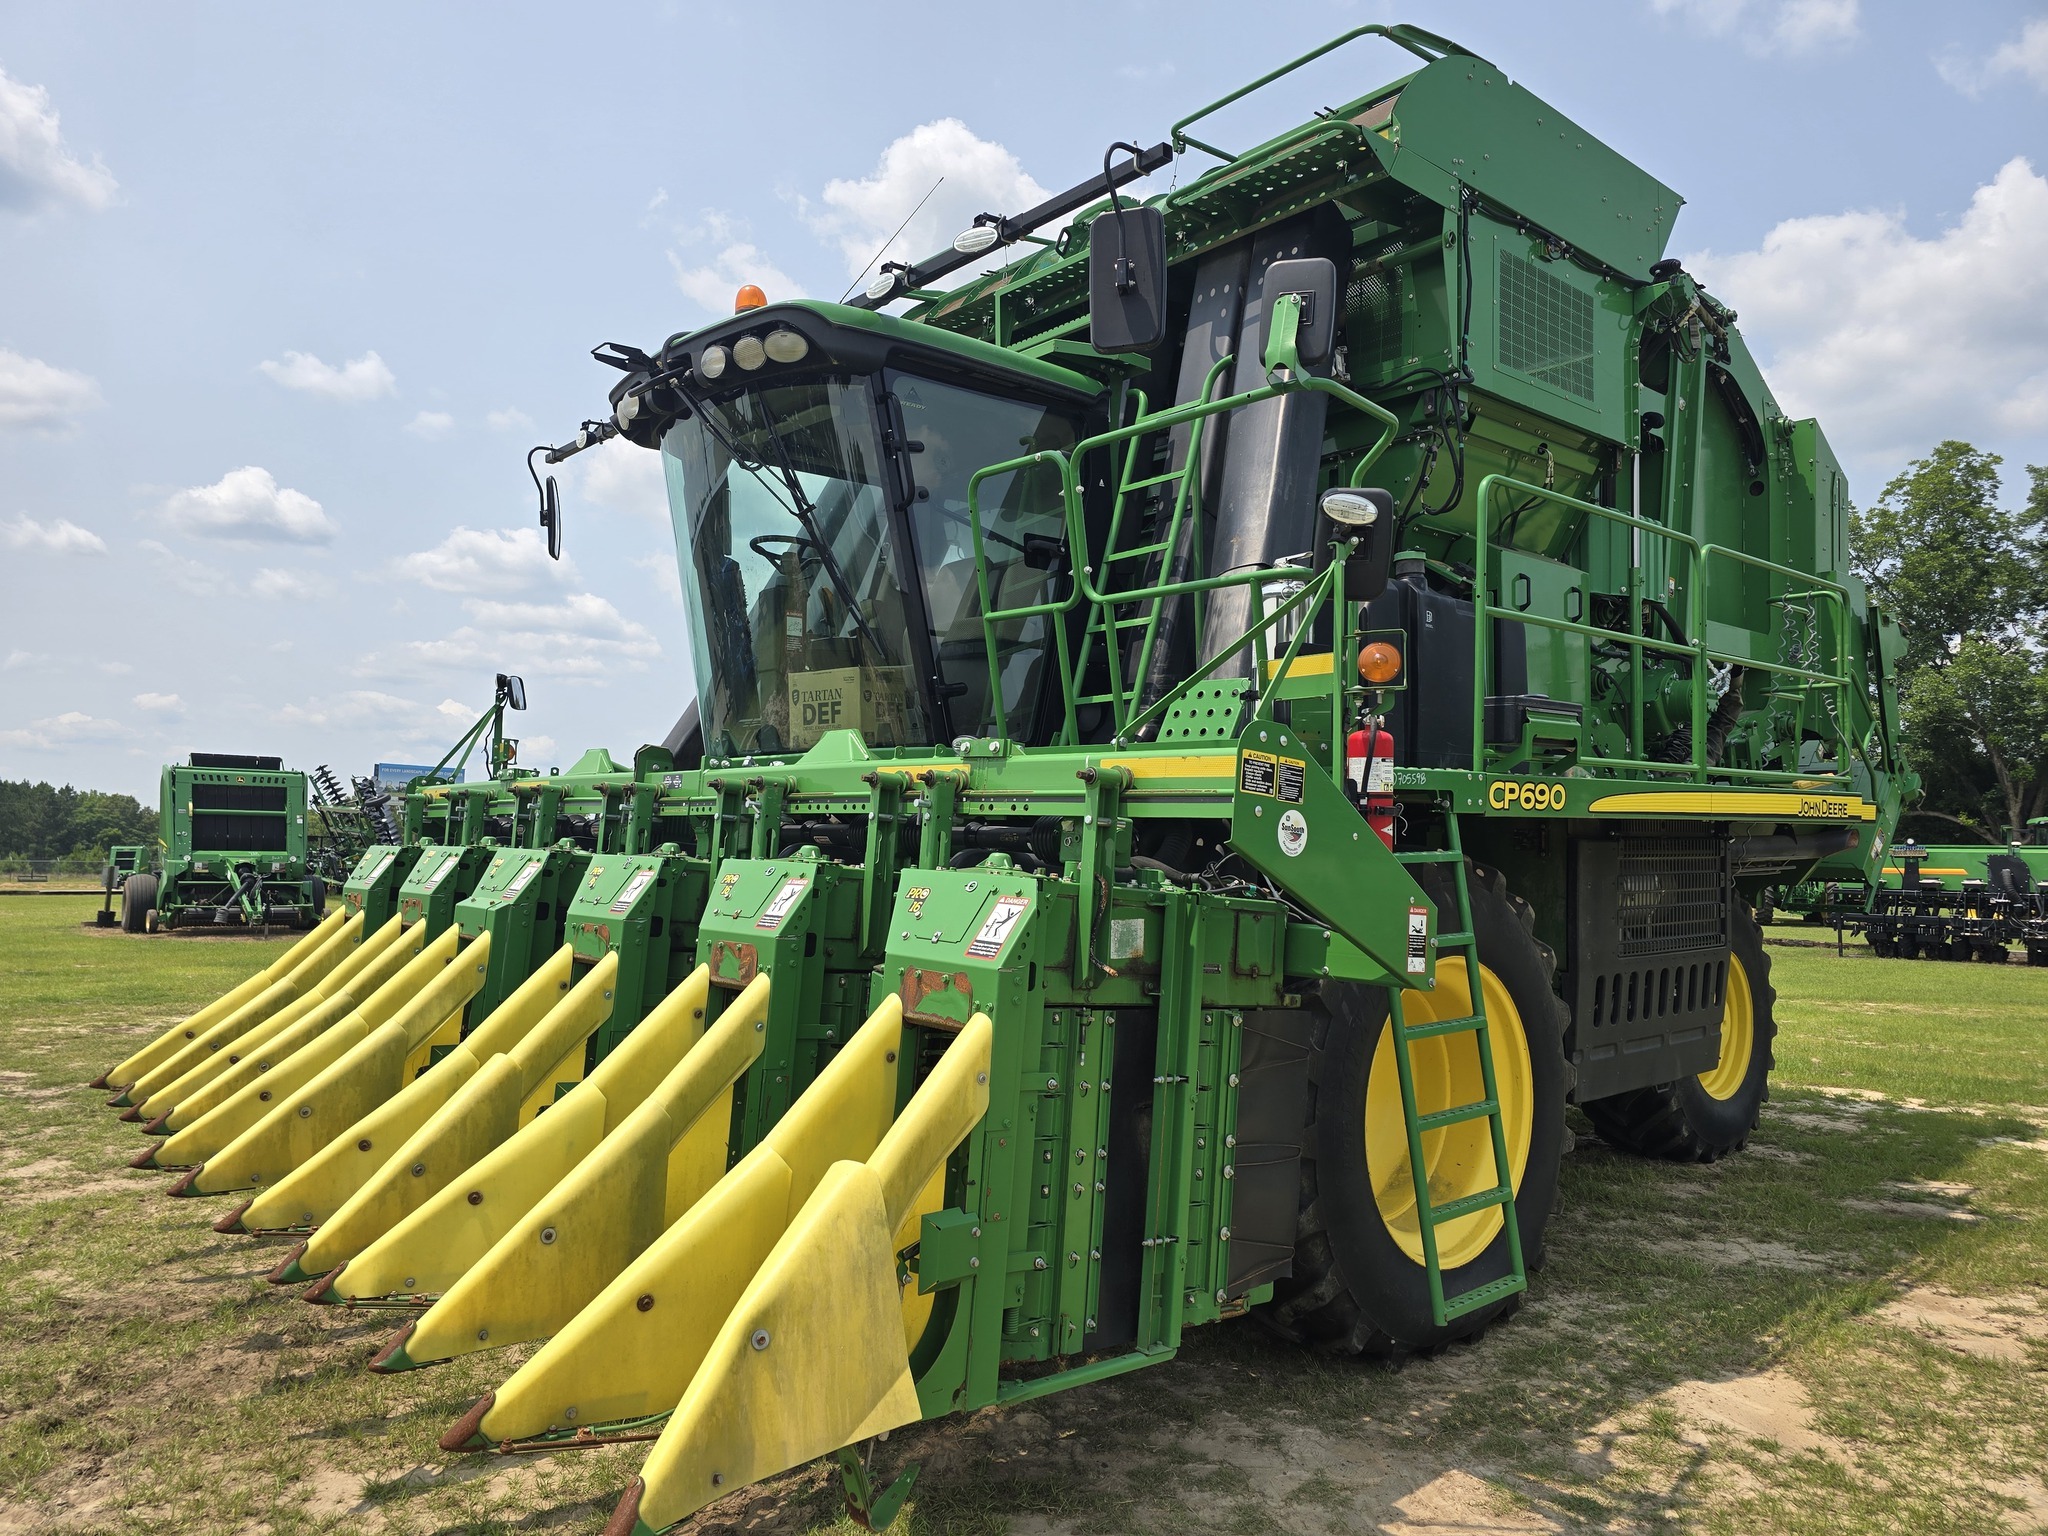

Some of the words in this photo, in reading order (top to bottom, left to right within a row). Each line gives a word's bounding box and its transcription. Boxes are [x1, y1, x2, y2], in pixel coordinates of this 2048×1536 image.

[801, 688, 842, 702] TARTAN
[803, 701, 842, 726] DEF
[1253, 753, 1272, 762] CAUTION
[1488, 780, 1566, 811] CP690
[1798, 798, 1821, 816] JOHN
[1821, 799, 1848, 817] DEERE
[720, 874, 740, 884] PRO
[905, 887, 931, 899] PRO
[908, 901, 922, 912] 16
